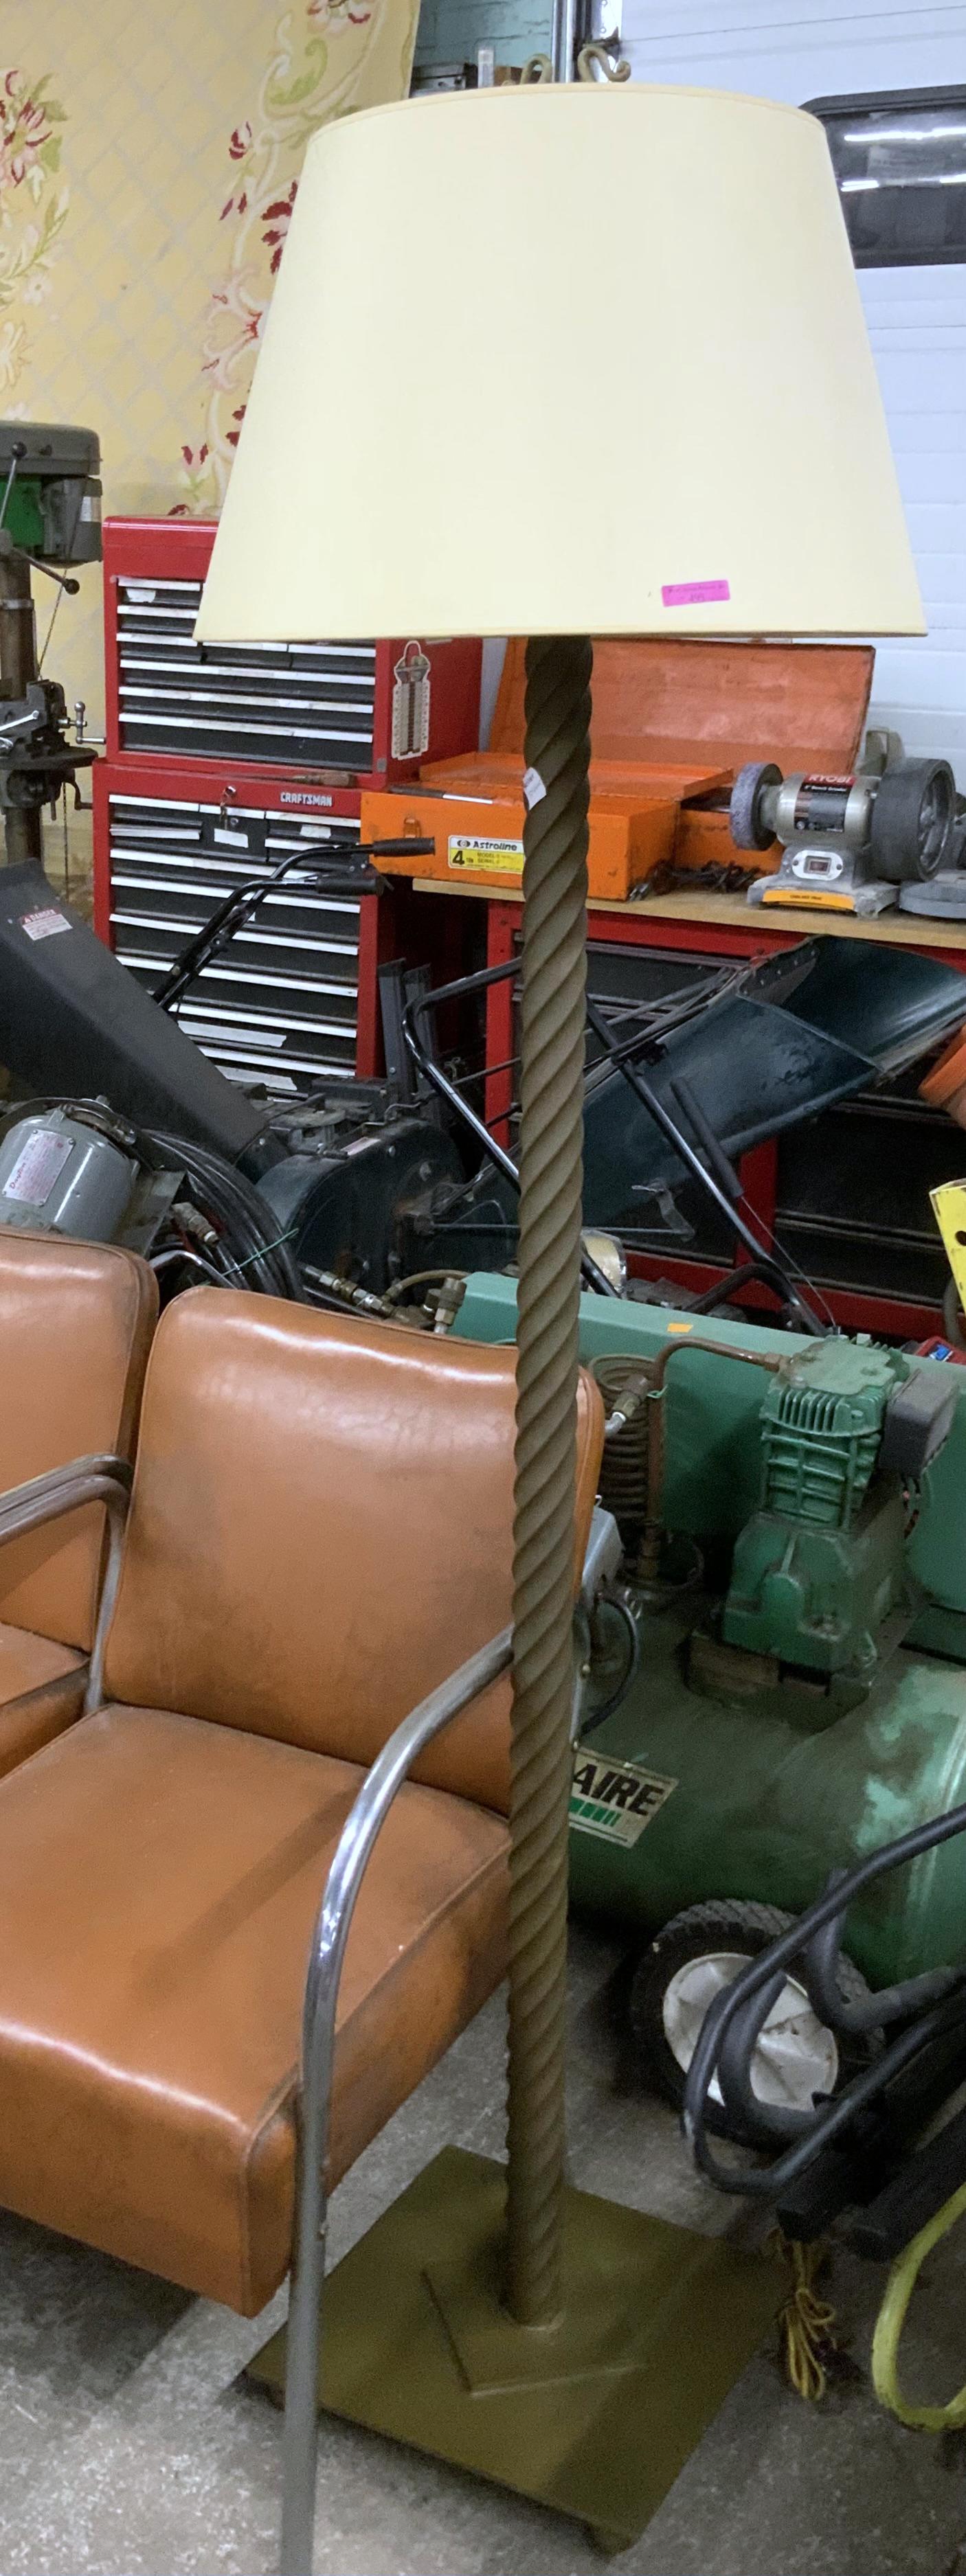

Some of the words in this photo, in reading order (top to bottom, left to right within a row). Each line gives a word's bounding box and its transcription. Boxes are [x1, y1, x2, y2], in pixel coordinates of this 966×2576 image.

[809, 774, 852, 783] RYOBI
[280, 792, 333, 807] CRAFTSMAN
[473, 841, 517, 851] Astroline
[452, 850, 464, 865] 4
